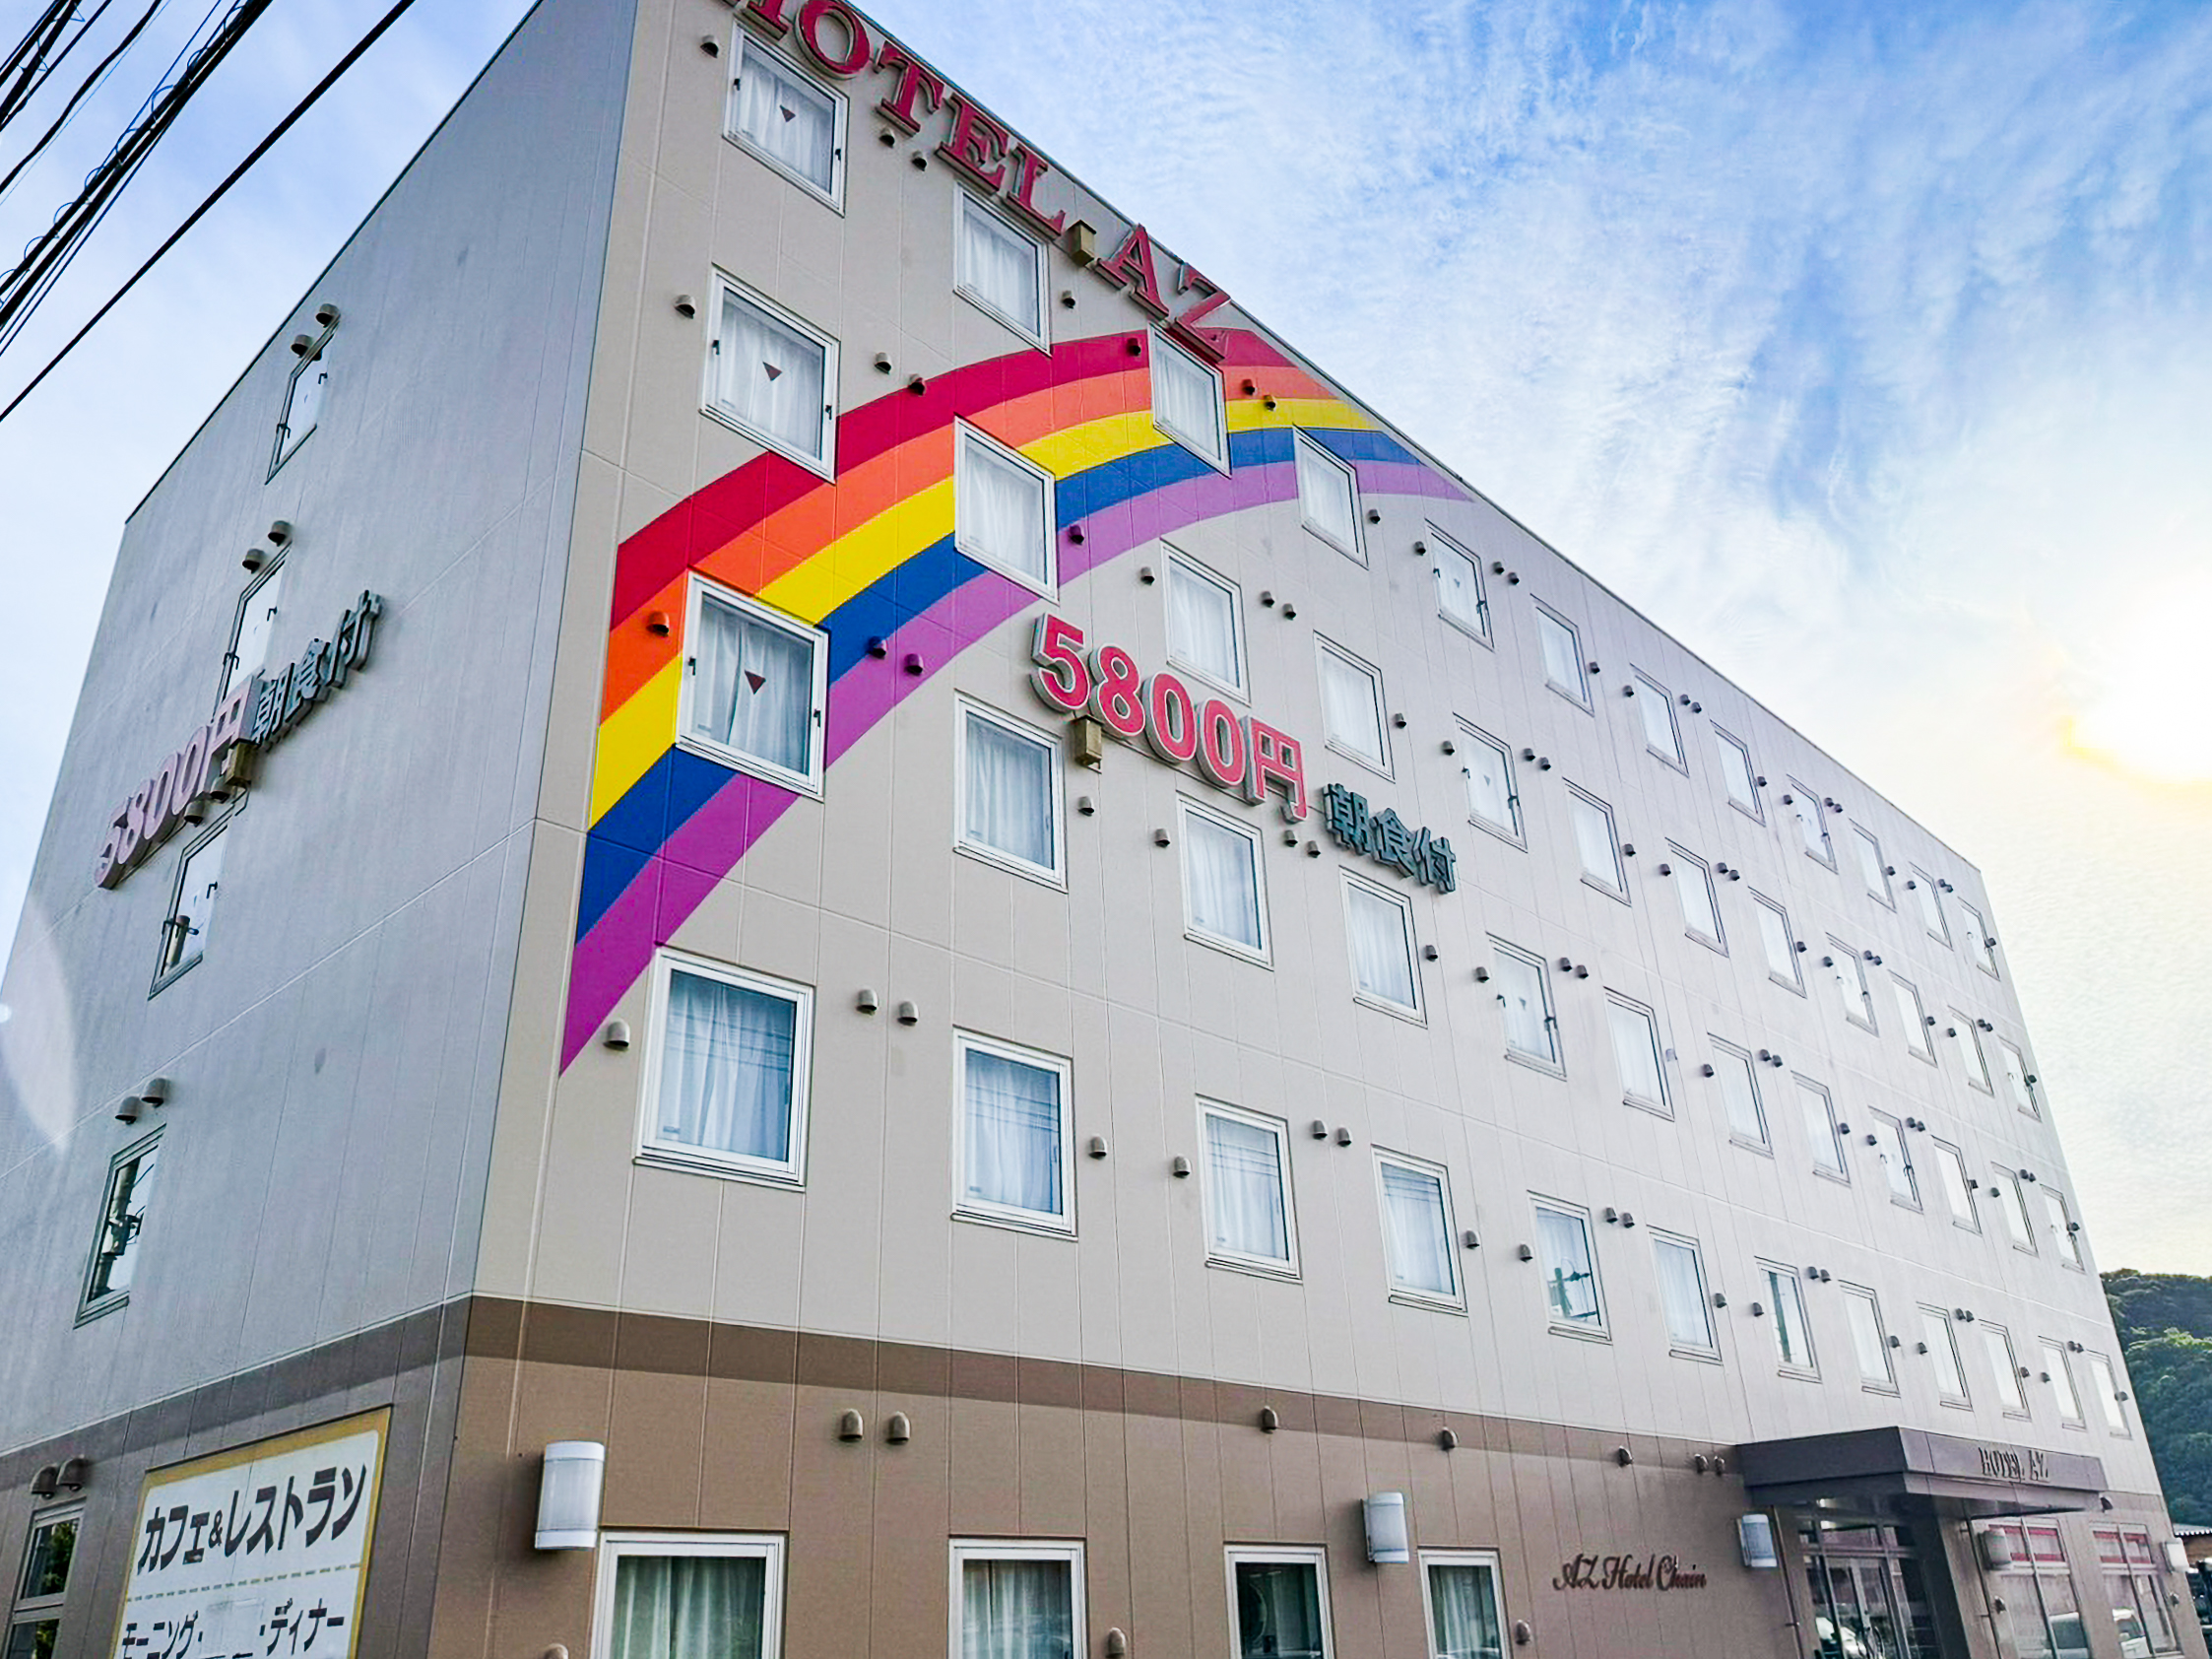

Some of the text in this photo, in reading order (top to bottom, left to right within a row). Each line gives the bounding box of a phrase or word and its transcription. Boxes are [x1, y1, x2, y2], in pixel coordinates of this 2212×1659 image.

[1093, 224, 1230, 363] AZ
[1029, 612, 1458, 895] 5800円 朝食付
[137, 1463, 367, 1576] カフェ&レストラン
[1601, 1554, 1654, 1591] Hotel
[1657, 1555, 1707, 1592] Chain
